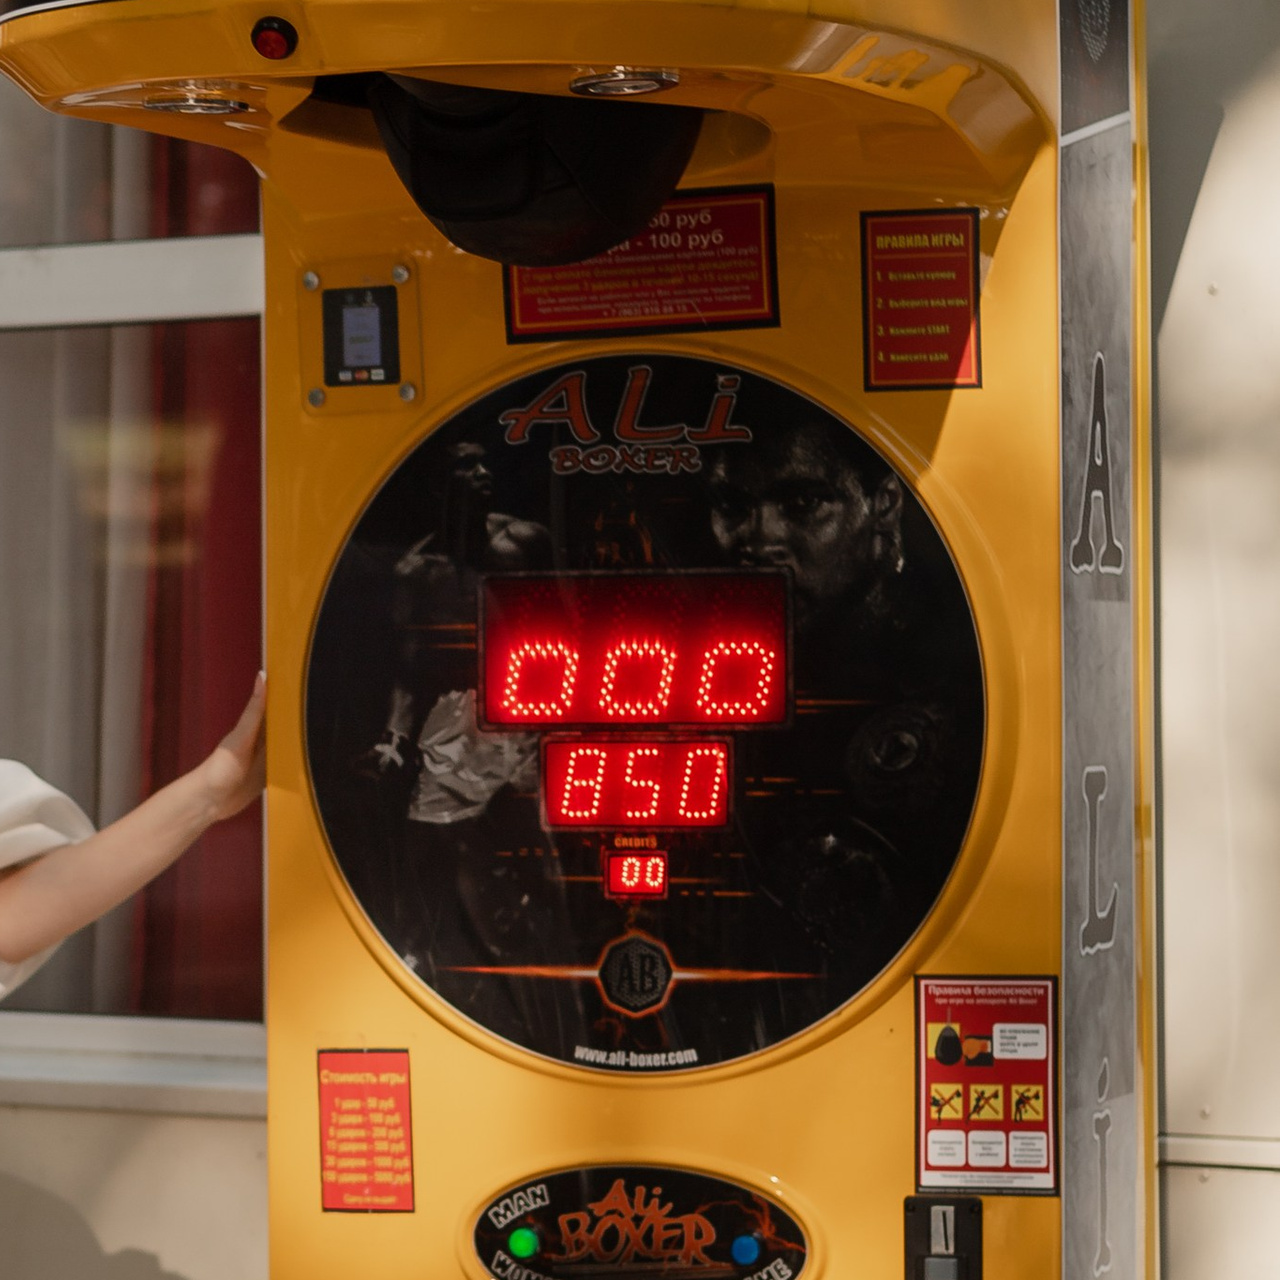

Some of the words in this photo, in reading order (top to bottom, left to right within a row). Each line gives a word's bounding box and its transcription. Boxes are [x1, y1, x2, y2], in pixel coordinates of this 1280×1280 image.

[676, 208, 713, 230] руб
[649, 232, 682, 249] 100
[688, 228, 724, 250] руб
[876, 233, 930, 250] ПРАВИЛА
[931, 232, 965, 248] ИГРЫ
[549, 444, 703, 476] BOXER
[500, 641, 778, 718] 000
[559, 746, 726, 821] 850
[613, 836, 659, 848] CREDITS
[620, 855, 665, 888] 00
[928, 985, 972, 997] Правила
[974, 985, 1045, 996] безопасности
[574, 1044, 700, 1068] www.ali-boxer.com
[320, 1069, 378, 1085] Стоимость
[379, 1072, 407, 1087] игры
[488, 1183, 550, 1229] MAN
[588, 1178, 673, 1218] Ali
[556, 1210, 718, 1267] BOXER
